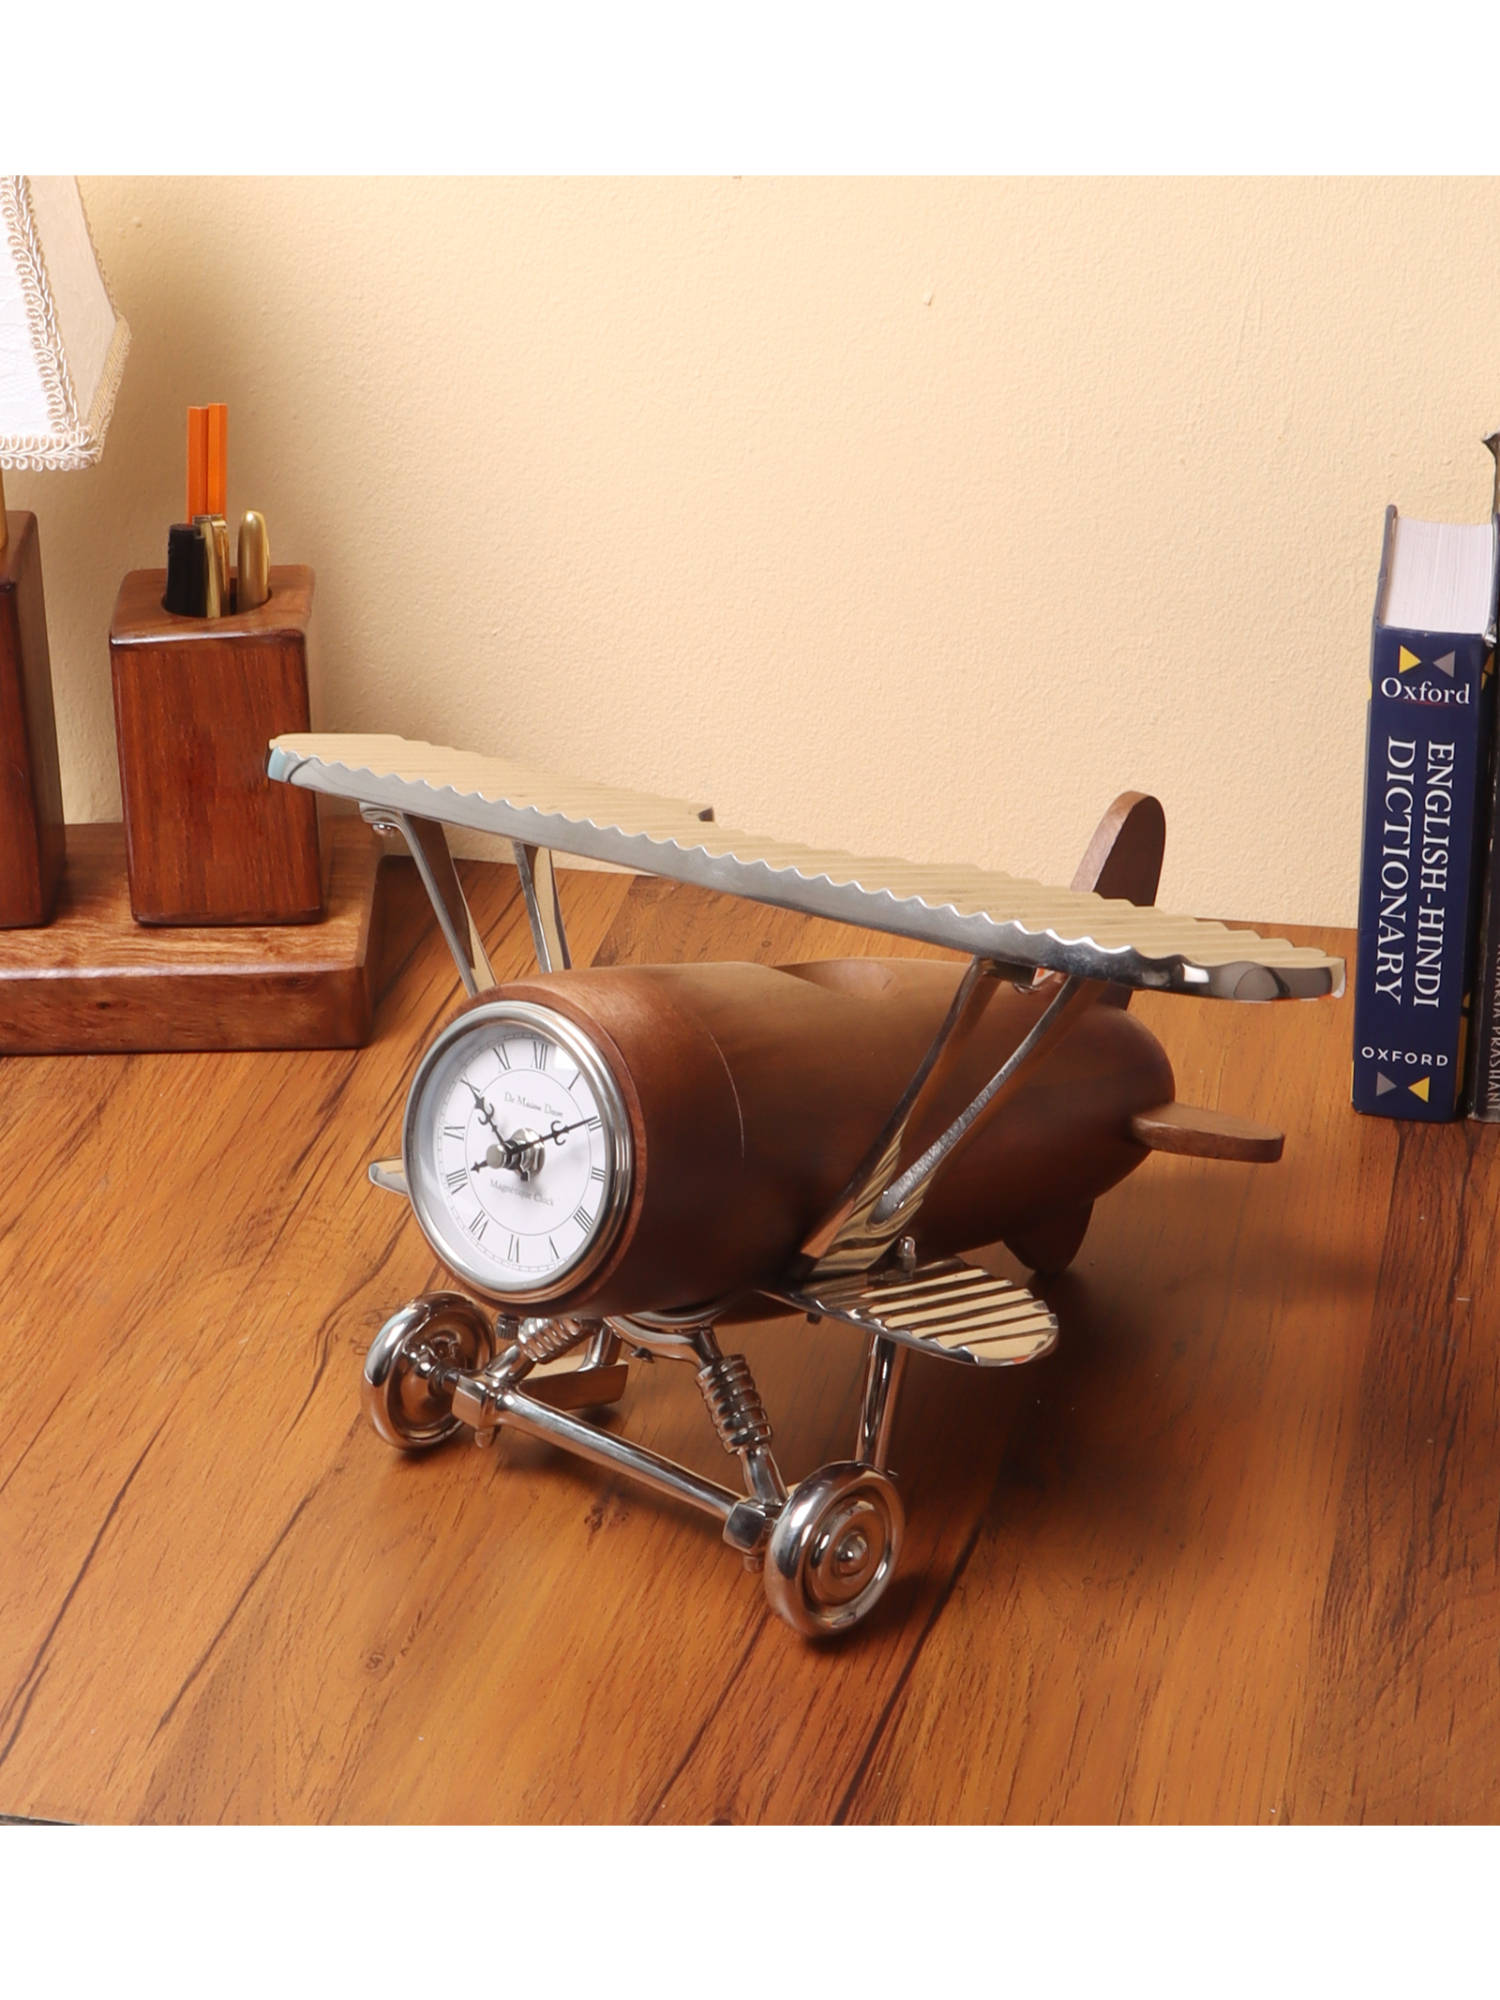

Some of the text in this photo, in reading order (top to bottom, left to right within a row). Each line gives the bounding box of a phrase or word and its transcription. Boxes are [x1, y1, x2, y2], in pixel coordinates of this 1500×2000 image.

[1381, 677, 1470, 704] Oxford
[1375, 736, 1417, 1006] DICTIONARY
[1413, 740, 1455, 1008] ENGLISH-HINDI
[1361, 1046, 1449, 1067] OXFORD
